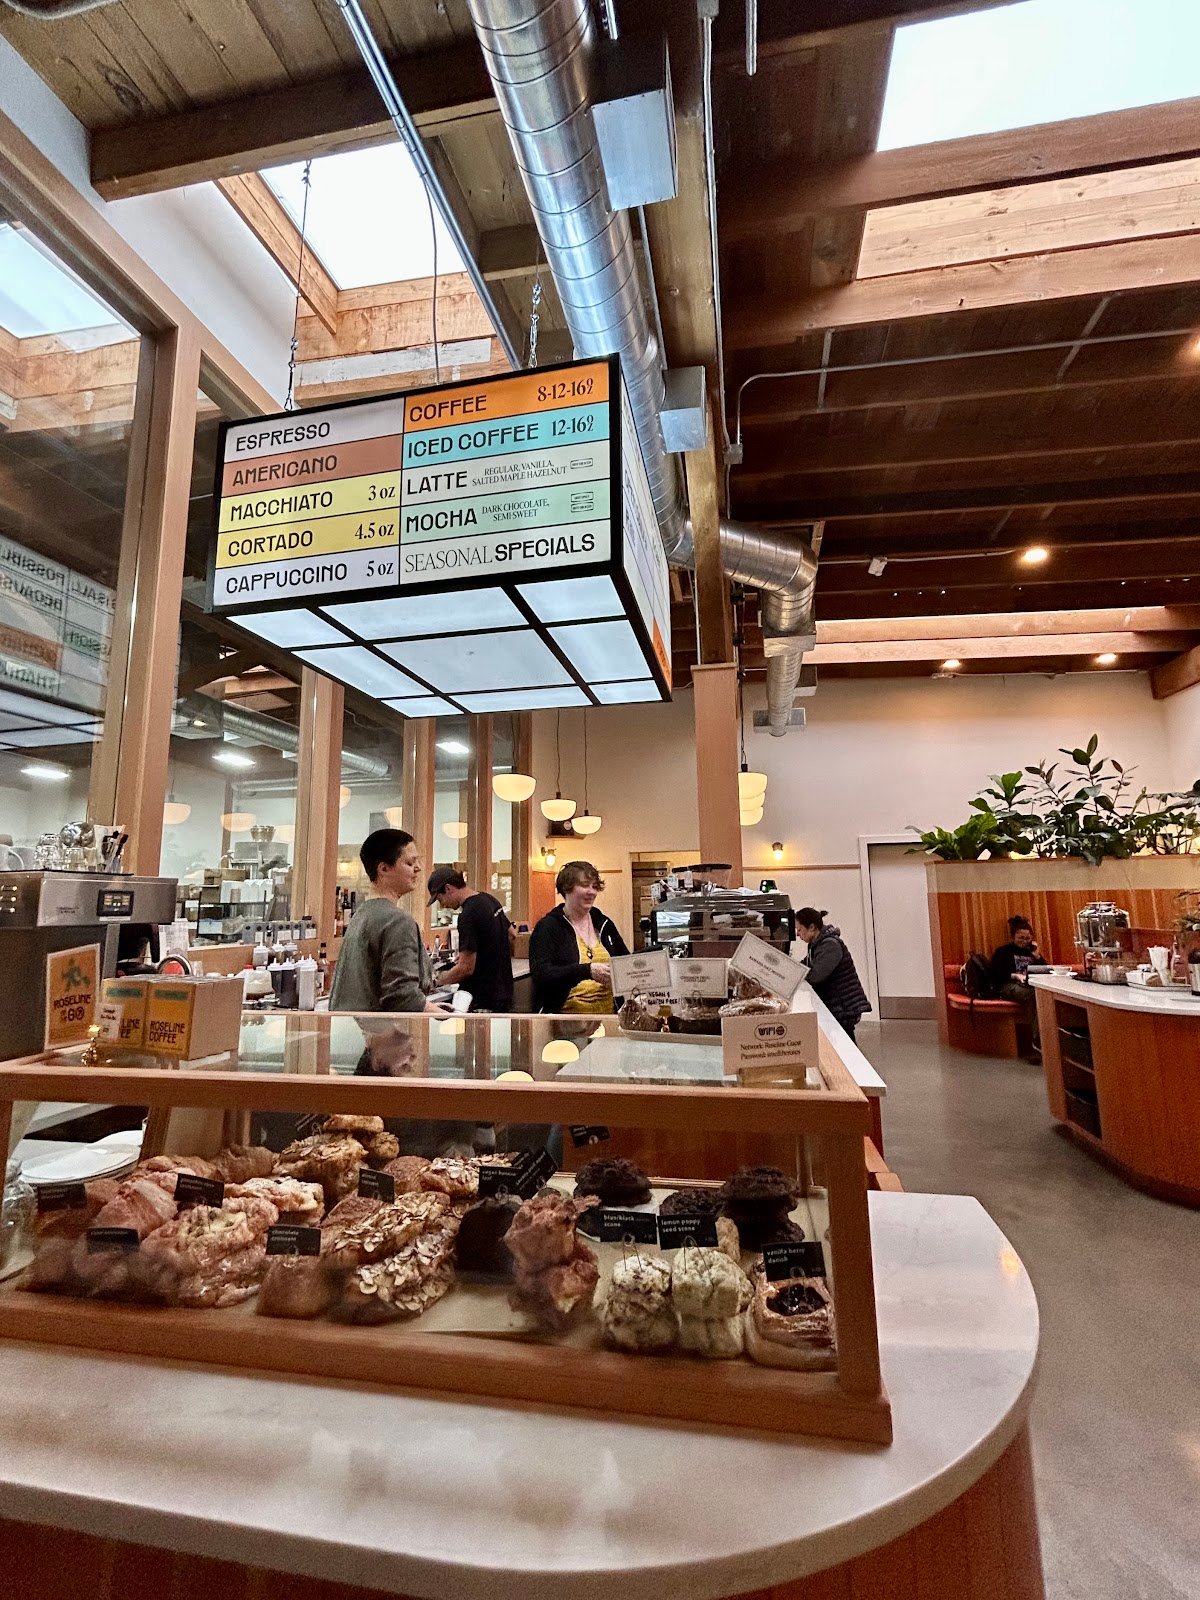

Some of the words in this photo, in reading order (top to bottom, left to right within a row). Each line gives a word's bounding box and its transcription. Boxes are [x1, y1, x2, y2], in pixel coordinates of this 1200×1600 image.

[409, 395, 487, 422] COFFEE
[236, 422, 331, 451] ESPRESSO
[408, 436, 453, 459] ICED
[458, 422, 539, 450] COFFEE
[233, 455, 337, 487] AMERICANO
[472, 475, 499, 486] SALTED
[500, 472, 526, 482] MAPLE
[527, 466, 567, 479] HAZELNUT
[484, 464, 520, 476] REGULAR,
[521, 460, 554, 470] VANILLA,
[407, 471, 468, 495] LATTE
[231, 491, 333, 521] MACCHIATO
[368, 485, 377, 501] 3
[380, 486, 396, 499] oz
[482, 504, 502, 514] DARK
[503, 498, 549, 511] CHOCOLATE,
[406, 508, 478, 533] MOCHA
[228, 530, 313, 557] CORTADO
[354, 522, 376, 540] 4.5
[379, 523, 395, 537] oz
[405, 546, 493, 573] SEASONAL
[494, 533, 595, 562] SPECIALS
[226, 563, 347, 594] CAPPUCCINO
[366, 560, 375, 577] 5
[378, 562, 394, 576] oz
[54, 994, 92, 1010] ROSELINE
[149, 1031, 177, 1044] COFFEE
[150, 1020, 186, 1034] ROSELINE
